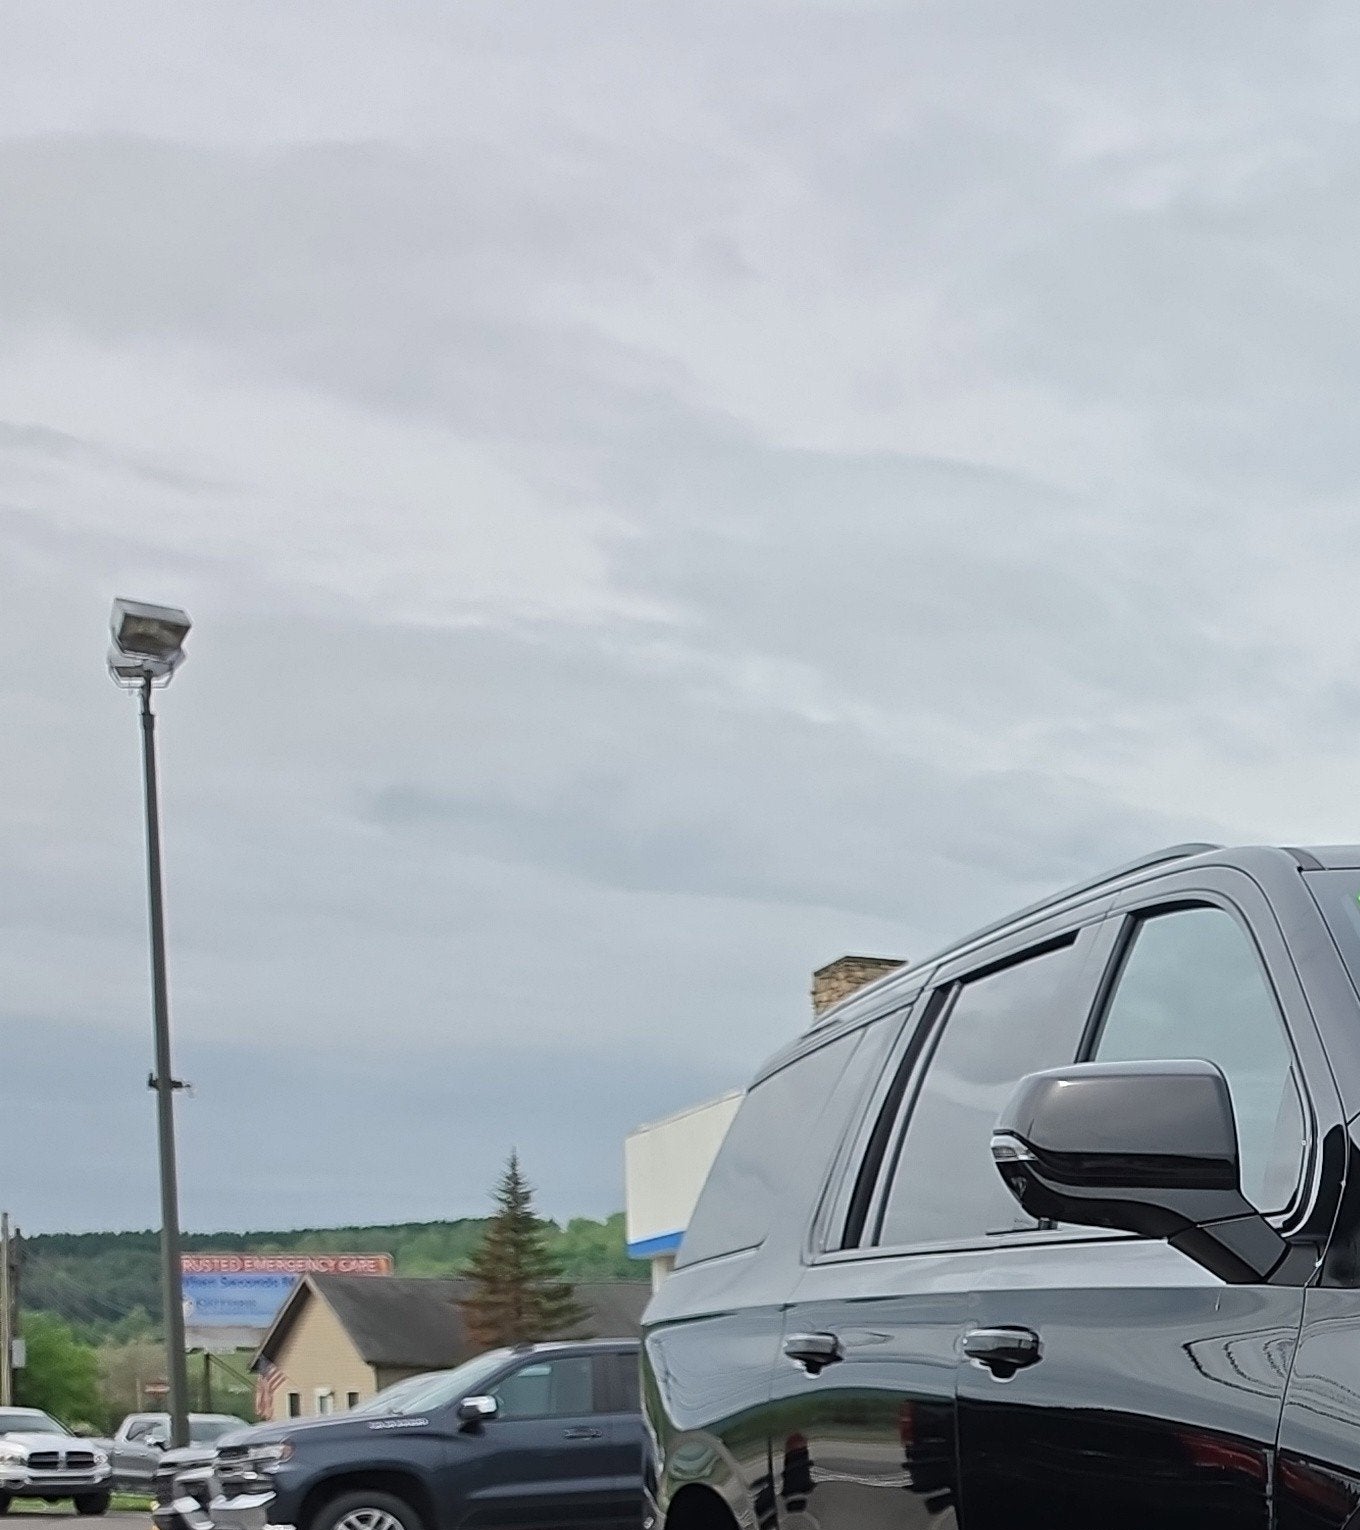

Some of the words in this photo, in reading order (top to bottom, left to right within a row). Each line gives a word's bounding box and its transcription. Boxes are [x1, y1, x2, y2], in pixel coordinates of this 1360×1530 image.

[181, 1258, 241, 1273] RUSTED
[243, 1258, 336, 1273] EMERGENCY
[338, 1258, 377, 1273] CARE
